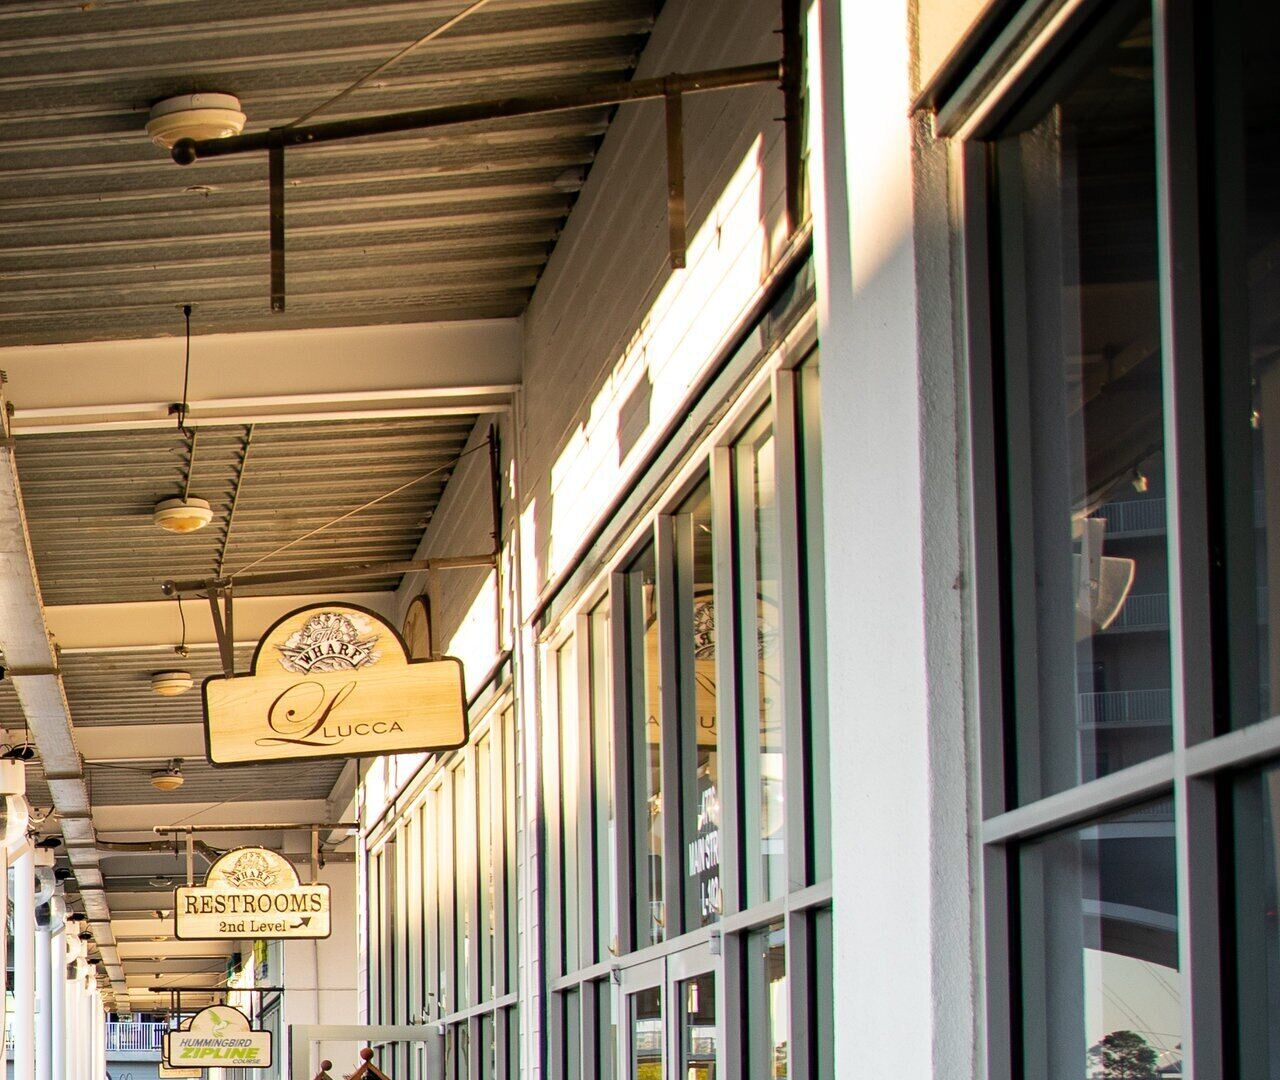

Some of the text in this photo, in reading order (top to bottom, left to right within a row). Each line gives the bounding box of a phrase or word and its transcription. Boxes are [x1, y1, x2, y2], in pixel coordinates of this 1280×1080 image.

[299, 642, 362, 665] WHARF
[323, 721, 404, 738] LUCCA
[233, 868, 270, 883] WHARF
[184, 893, 322, 914] RESTROOMS
[219, 920, 286, 932] 2nd Level
[180, 1038, 252, 1047] HUMMINGBIRD
[179, 1048, 260, 1059] ZIPLINE
